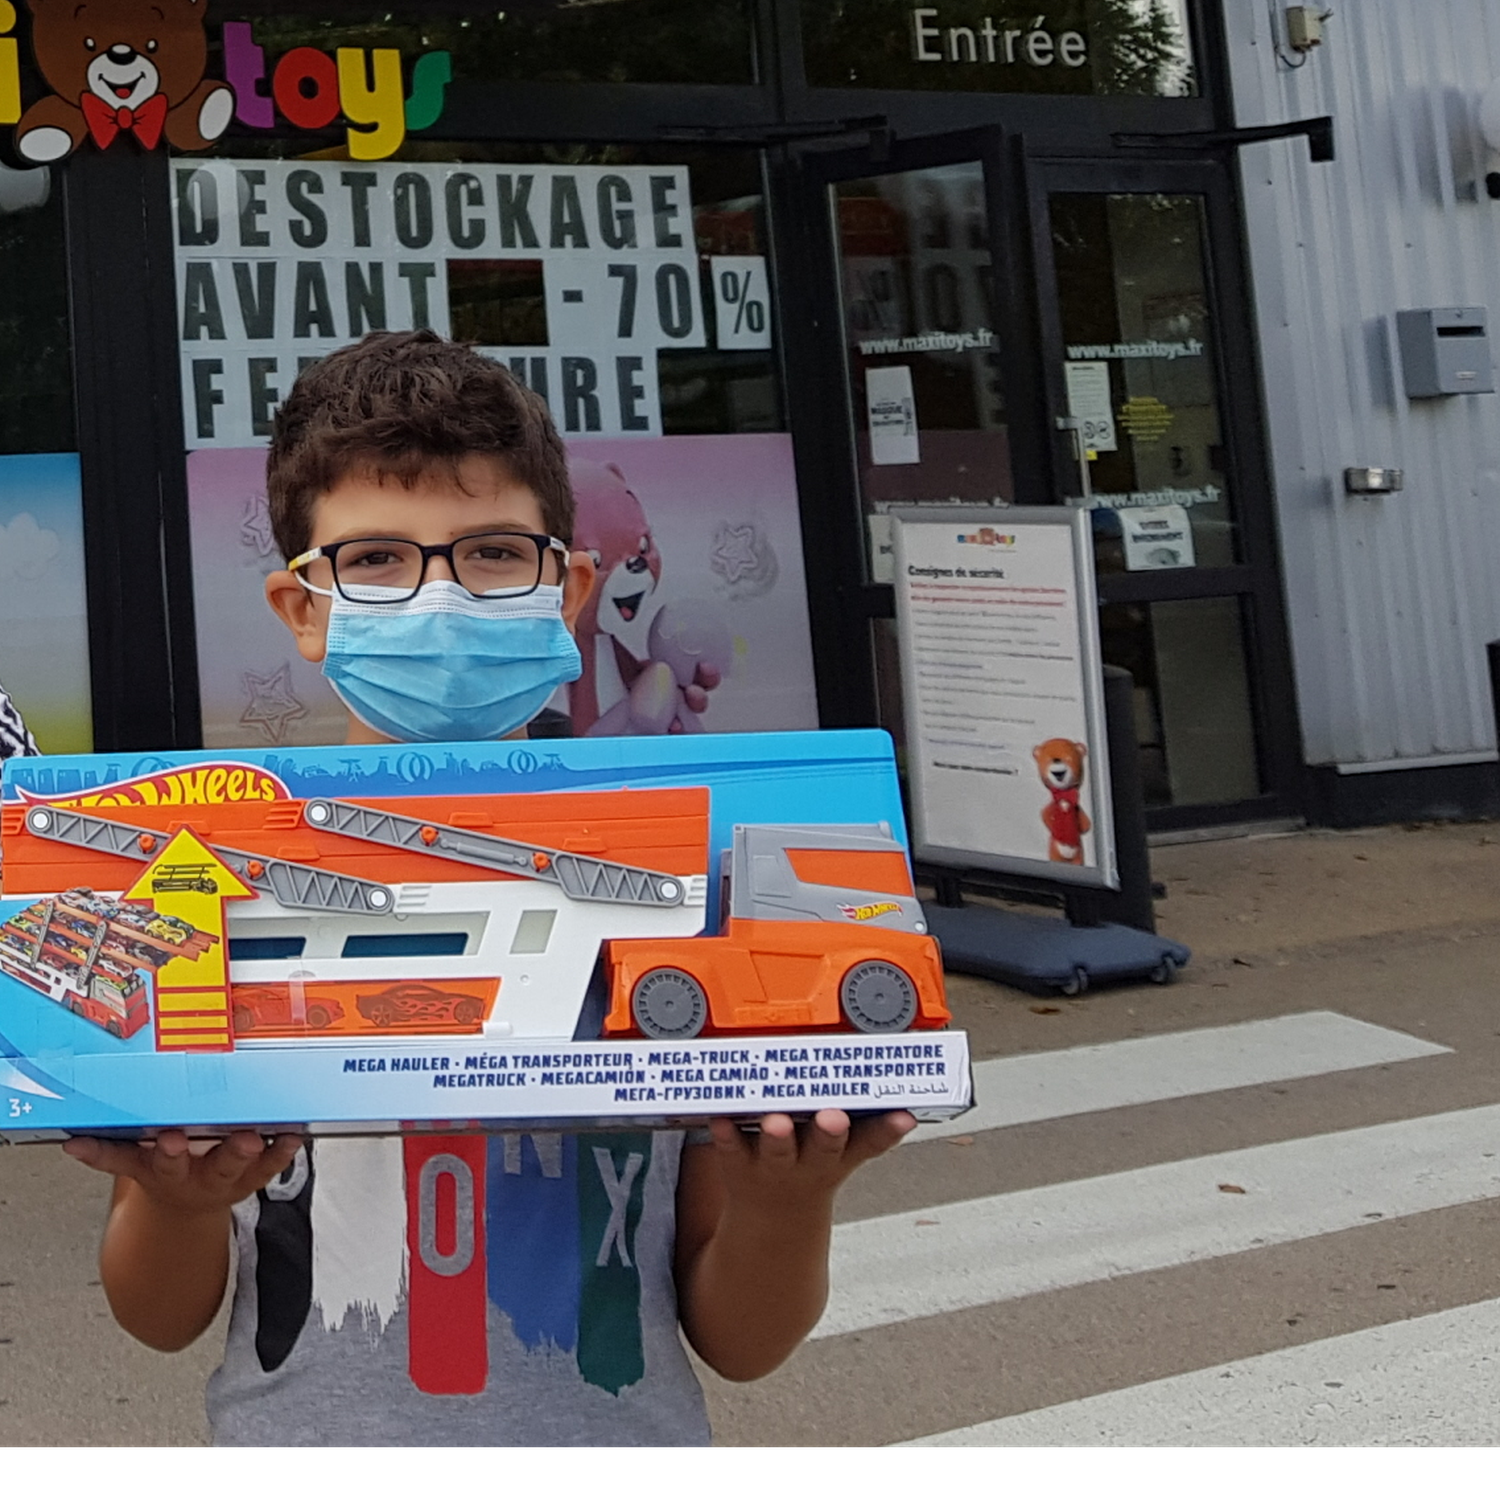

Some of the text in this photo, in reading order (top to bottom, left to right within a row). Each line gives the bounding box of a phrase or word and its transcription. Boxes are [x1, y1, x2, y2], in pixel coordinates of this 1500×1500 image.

[911, 7, 1088, 68] Entrée
[222, 21, 453, 160] toys
[174, 167, 684, 250] DESTOCKAGE
[182, 259, 436, 342] AVANT
[342, 1045, 944, 1073] MEGA HAULER MÉGA TRANSPORTEUR MEGA-TRUCK MEGA TRASPORTATORE
[433, 1062, 946, 1088] MEGATRUCK MEGACAMIÓN MEGA CAMIÃO MEGA TRANSPORTER
[9, 1098, 33, 1117] 3+
[762, 1084, 806, 1098] MEGA
[810, 1082, 870, 1097] HAULER
